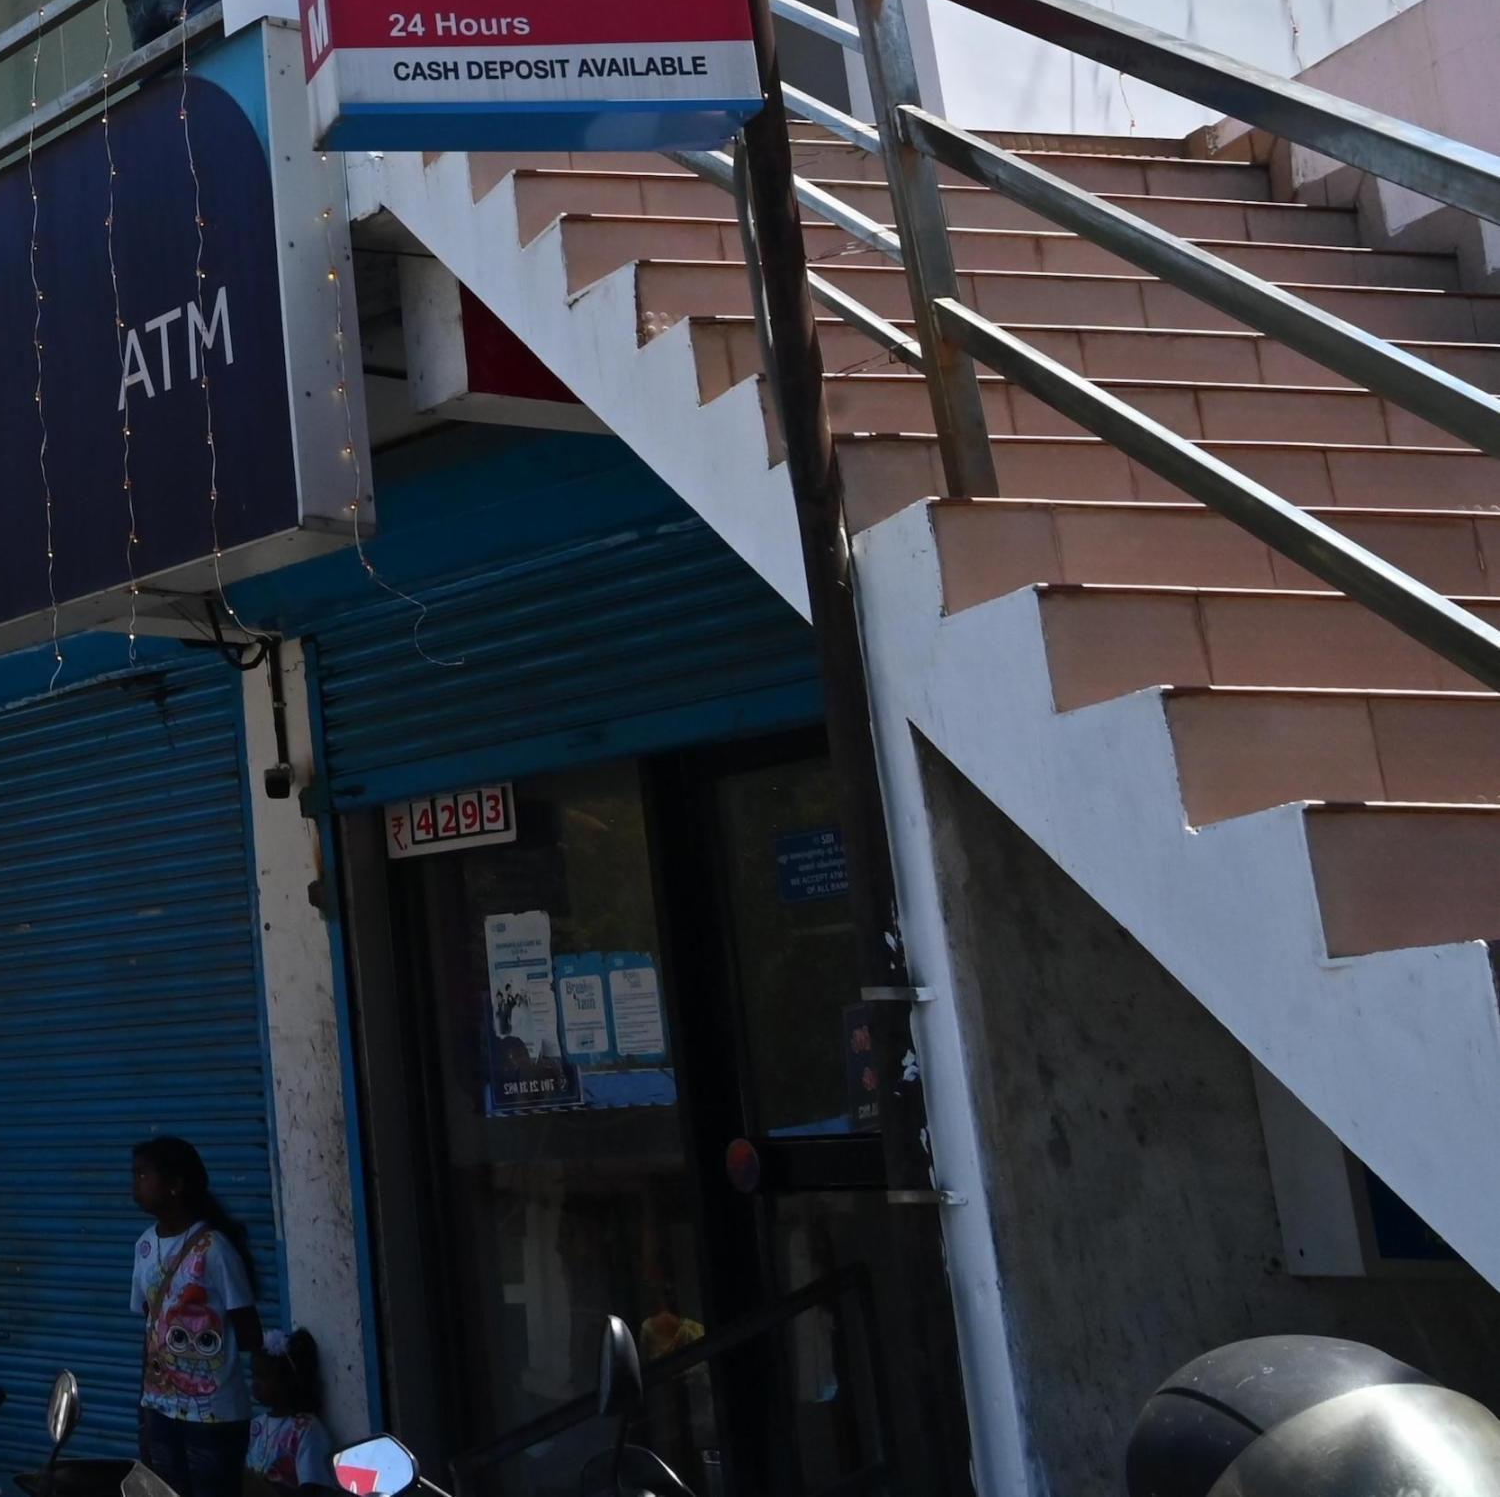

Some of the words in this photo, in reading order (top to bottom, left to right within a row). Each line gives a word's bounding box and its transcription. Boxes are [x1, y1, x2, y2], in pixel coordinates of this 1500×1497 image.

[388, 13, 426, 37] 24
[435, 12, 531, 37] Hours
[393, 59, 460, 81] CASH
[466, 58, 572, 81] DEPOSIT
[577, 56, 708, 78] AVAILABLE
[117, 286, 234, 412] ATM
